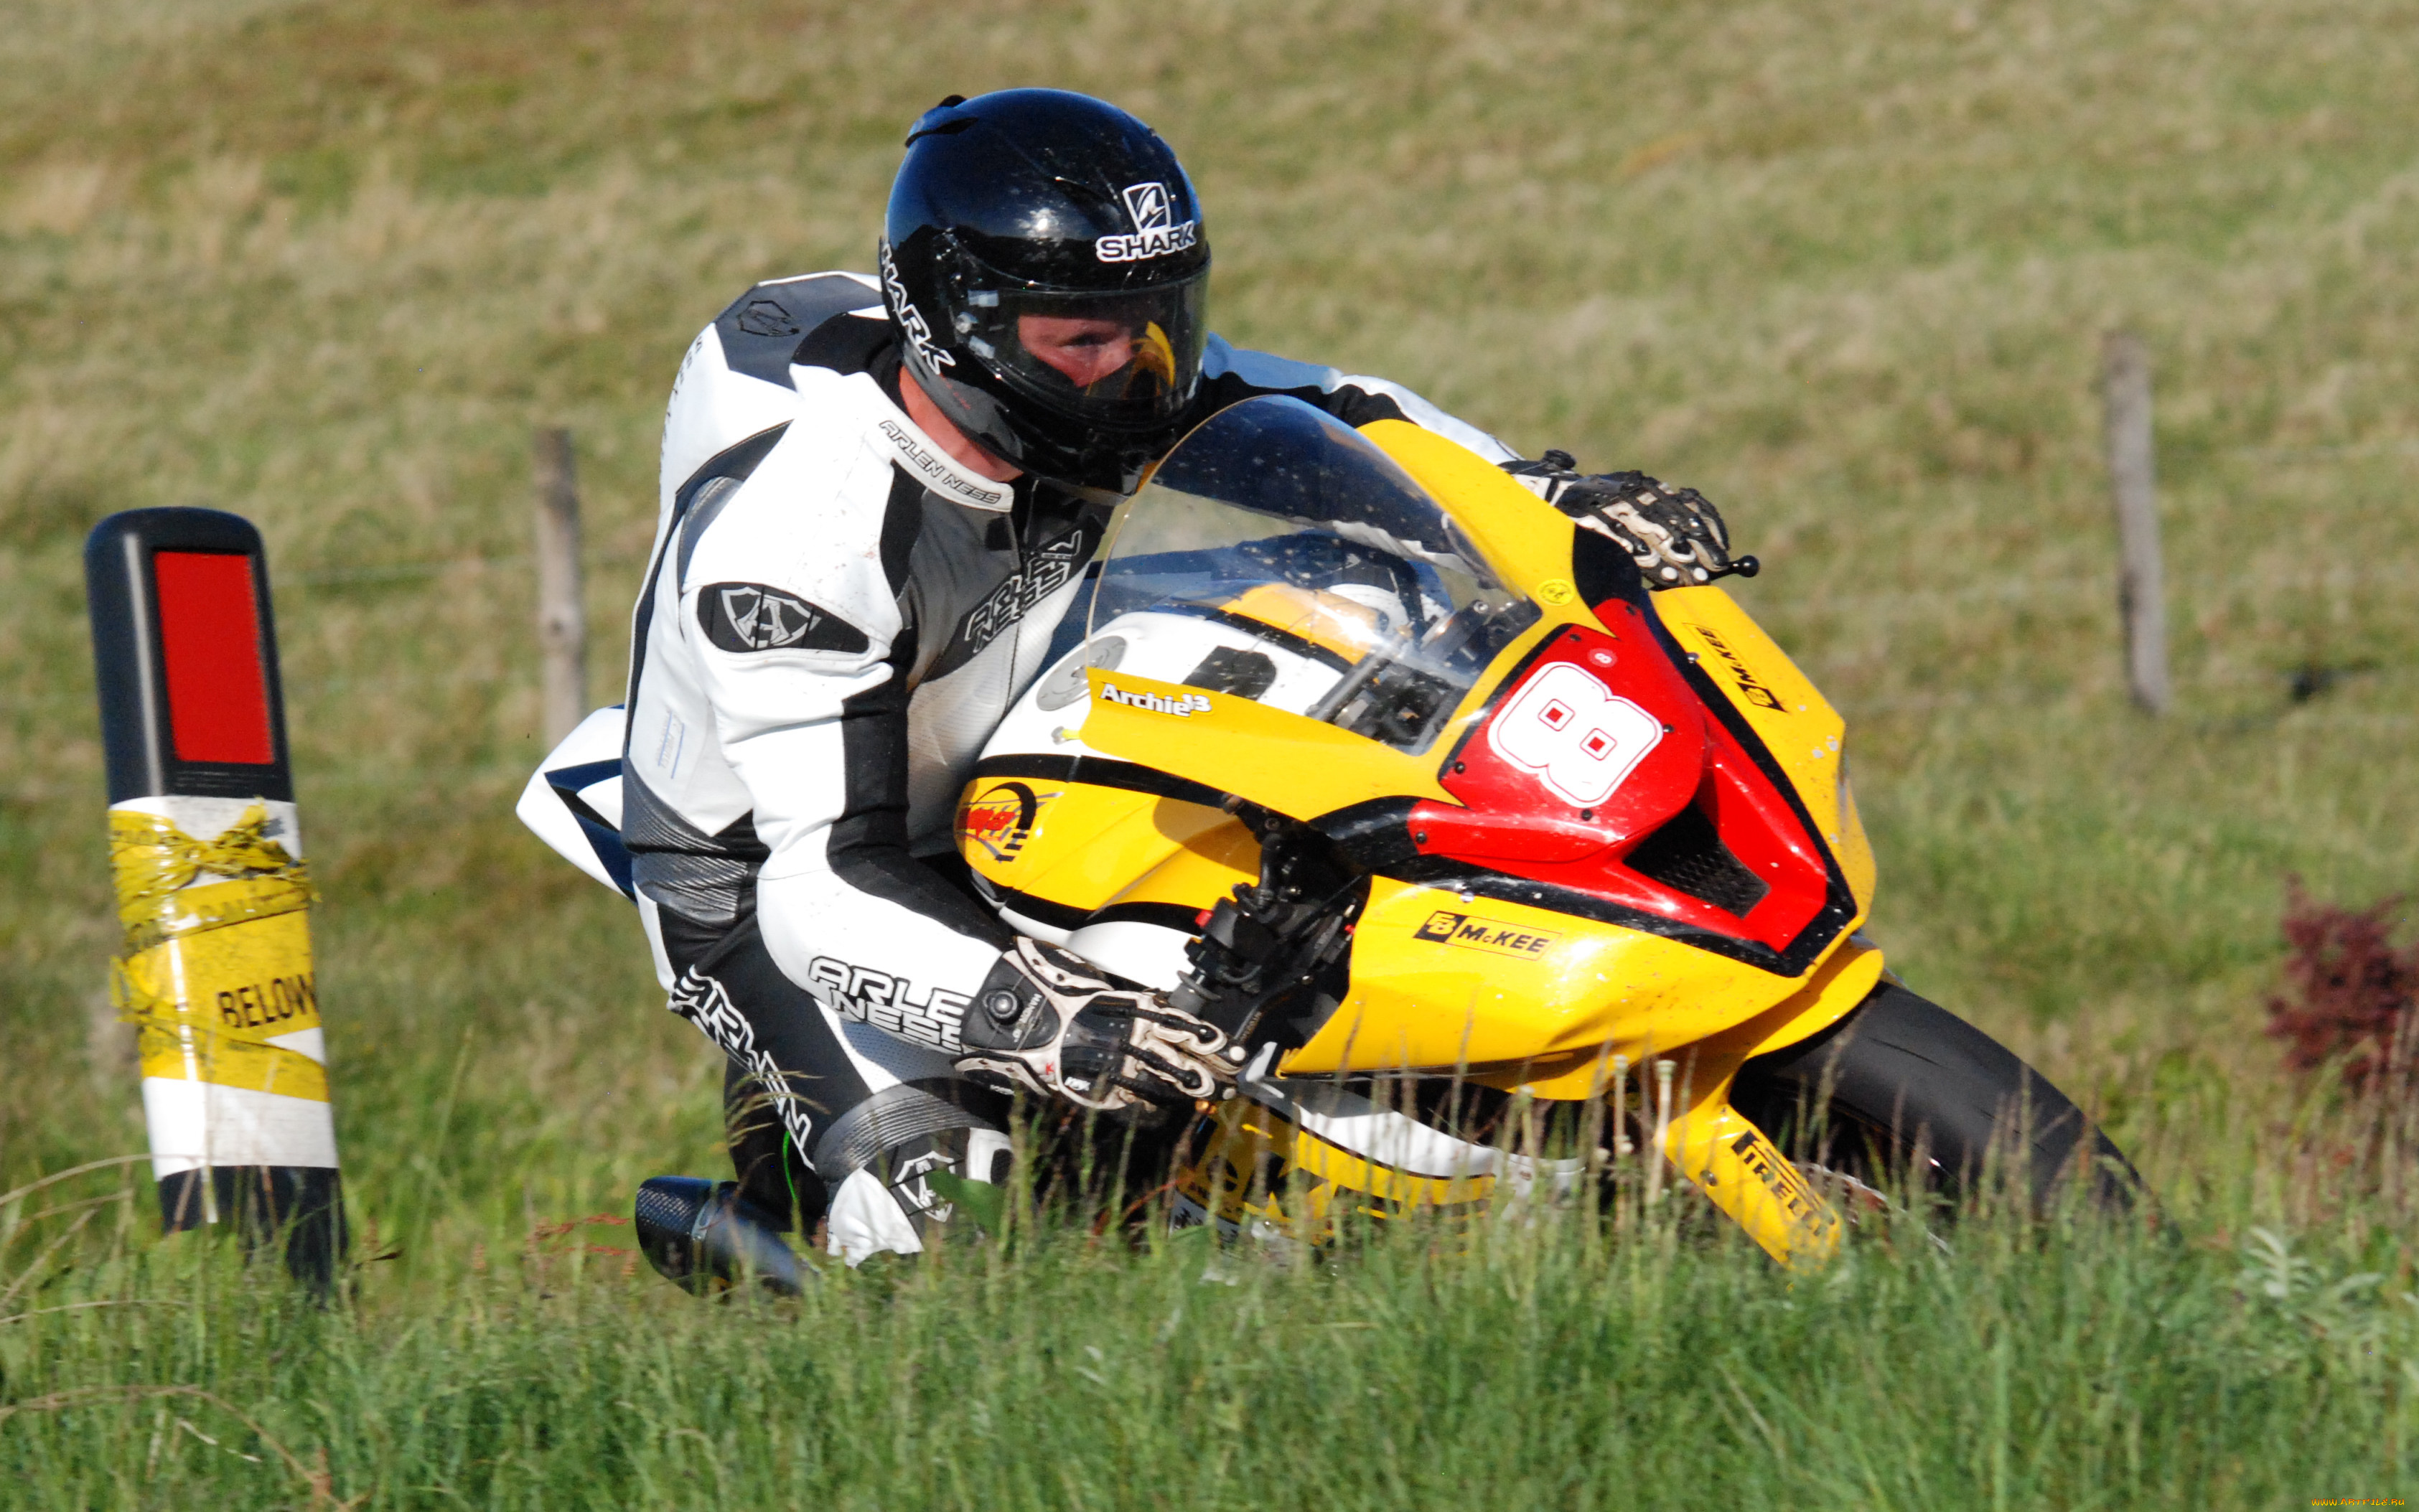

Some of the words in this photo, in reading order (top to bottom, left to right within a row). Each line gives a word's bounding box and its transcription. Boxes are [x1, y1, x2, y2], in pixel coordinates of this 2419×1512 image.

[1095, 220, 1197, 262] SHARK
[879, 420, 944, 478] ARLEN
[942, 474, 1002, 504] NESS
[1487, 661, 1664, 809] 8
[1457, 924, 1550, 953] McKEE
[808, 955, 976, 1028] ARLE
